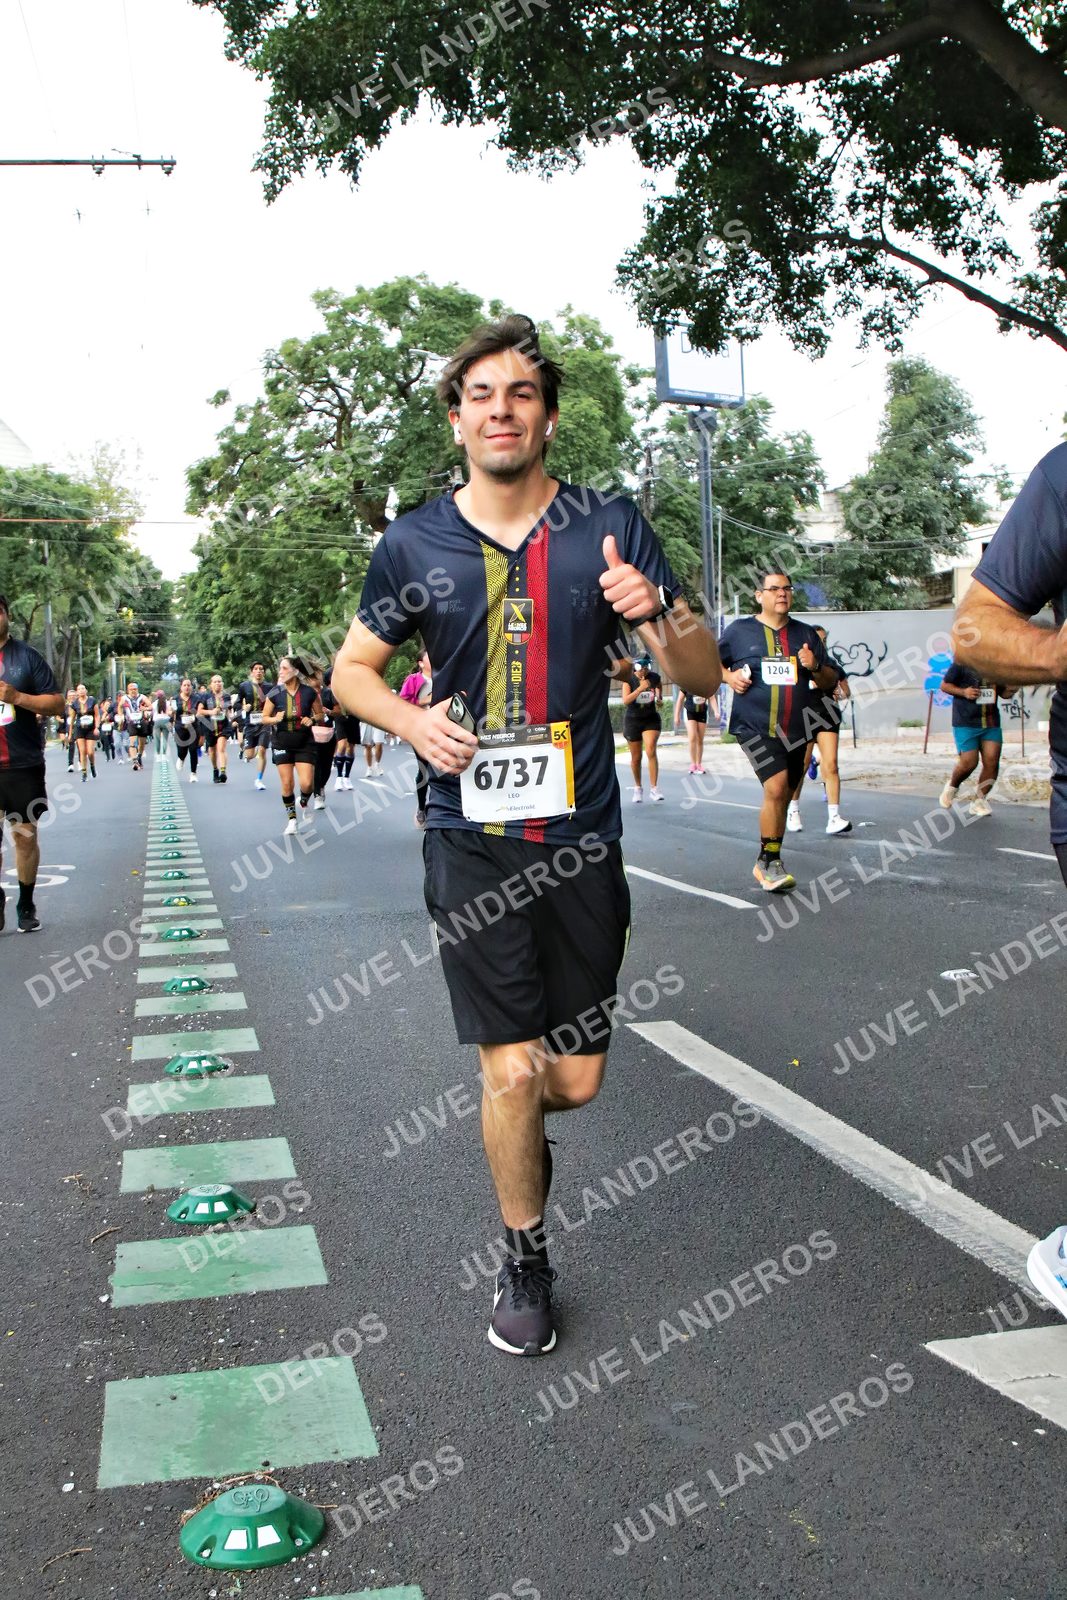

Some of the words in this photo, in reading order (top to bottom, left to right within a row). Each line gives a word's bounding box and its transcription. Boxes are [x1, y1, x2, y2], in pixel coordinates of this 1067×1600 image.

[767, 665, 790, 675] 1204
[553, 730, 567, 741] 5K
[474, 755, 549, 791] 6737
